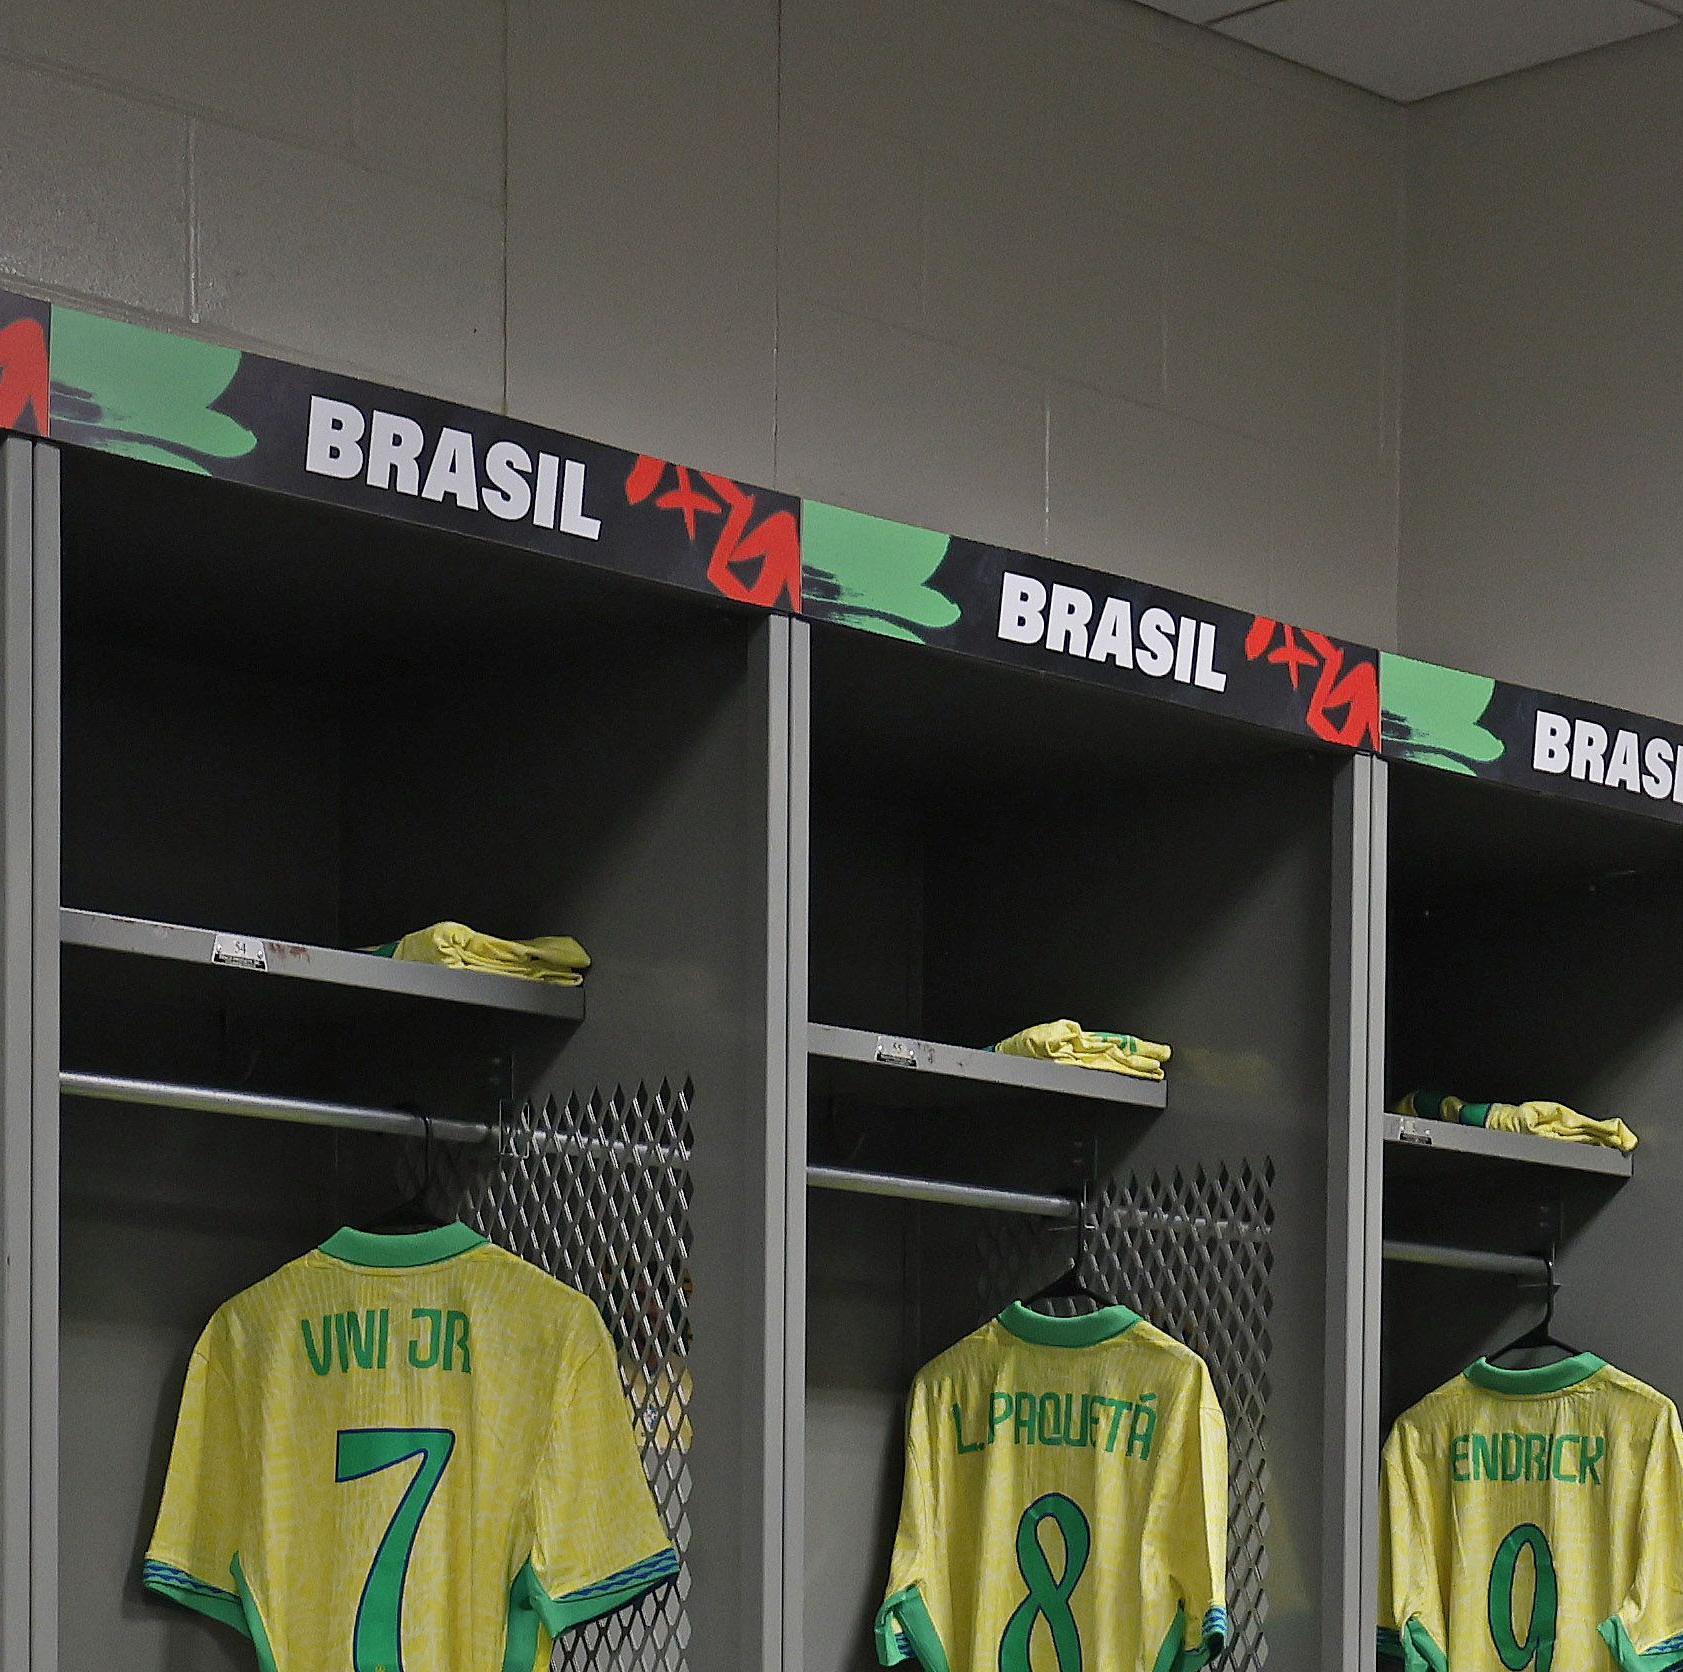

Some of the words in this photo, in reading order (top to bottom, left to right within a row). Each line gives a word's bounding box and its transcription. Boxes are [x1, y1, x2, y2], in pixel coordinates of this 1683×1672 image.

[305, 395, 602, 541] BRASIL
[997, 571, 1227, 693] BRASIL
[302, 1310, 390, 1377] VINI
[409, 1308, 472, 1374] JR
[1450, 1433, 1606, 1485] ENDRICK
